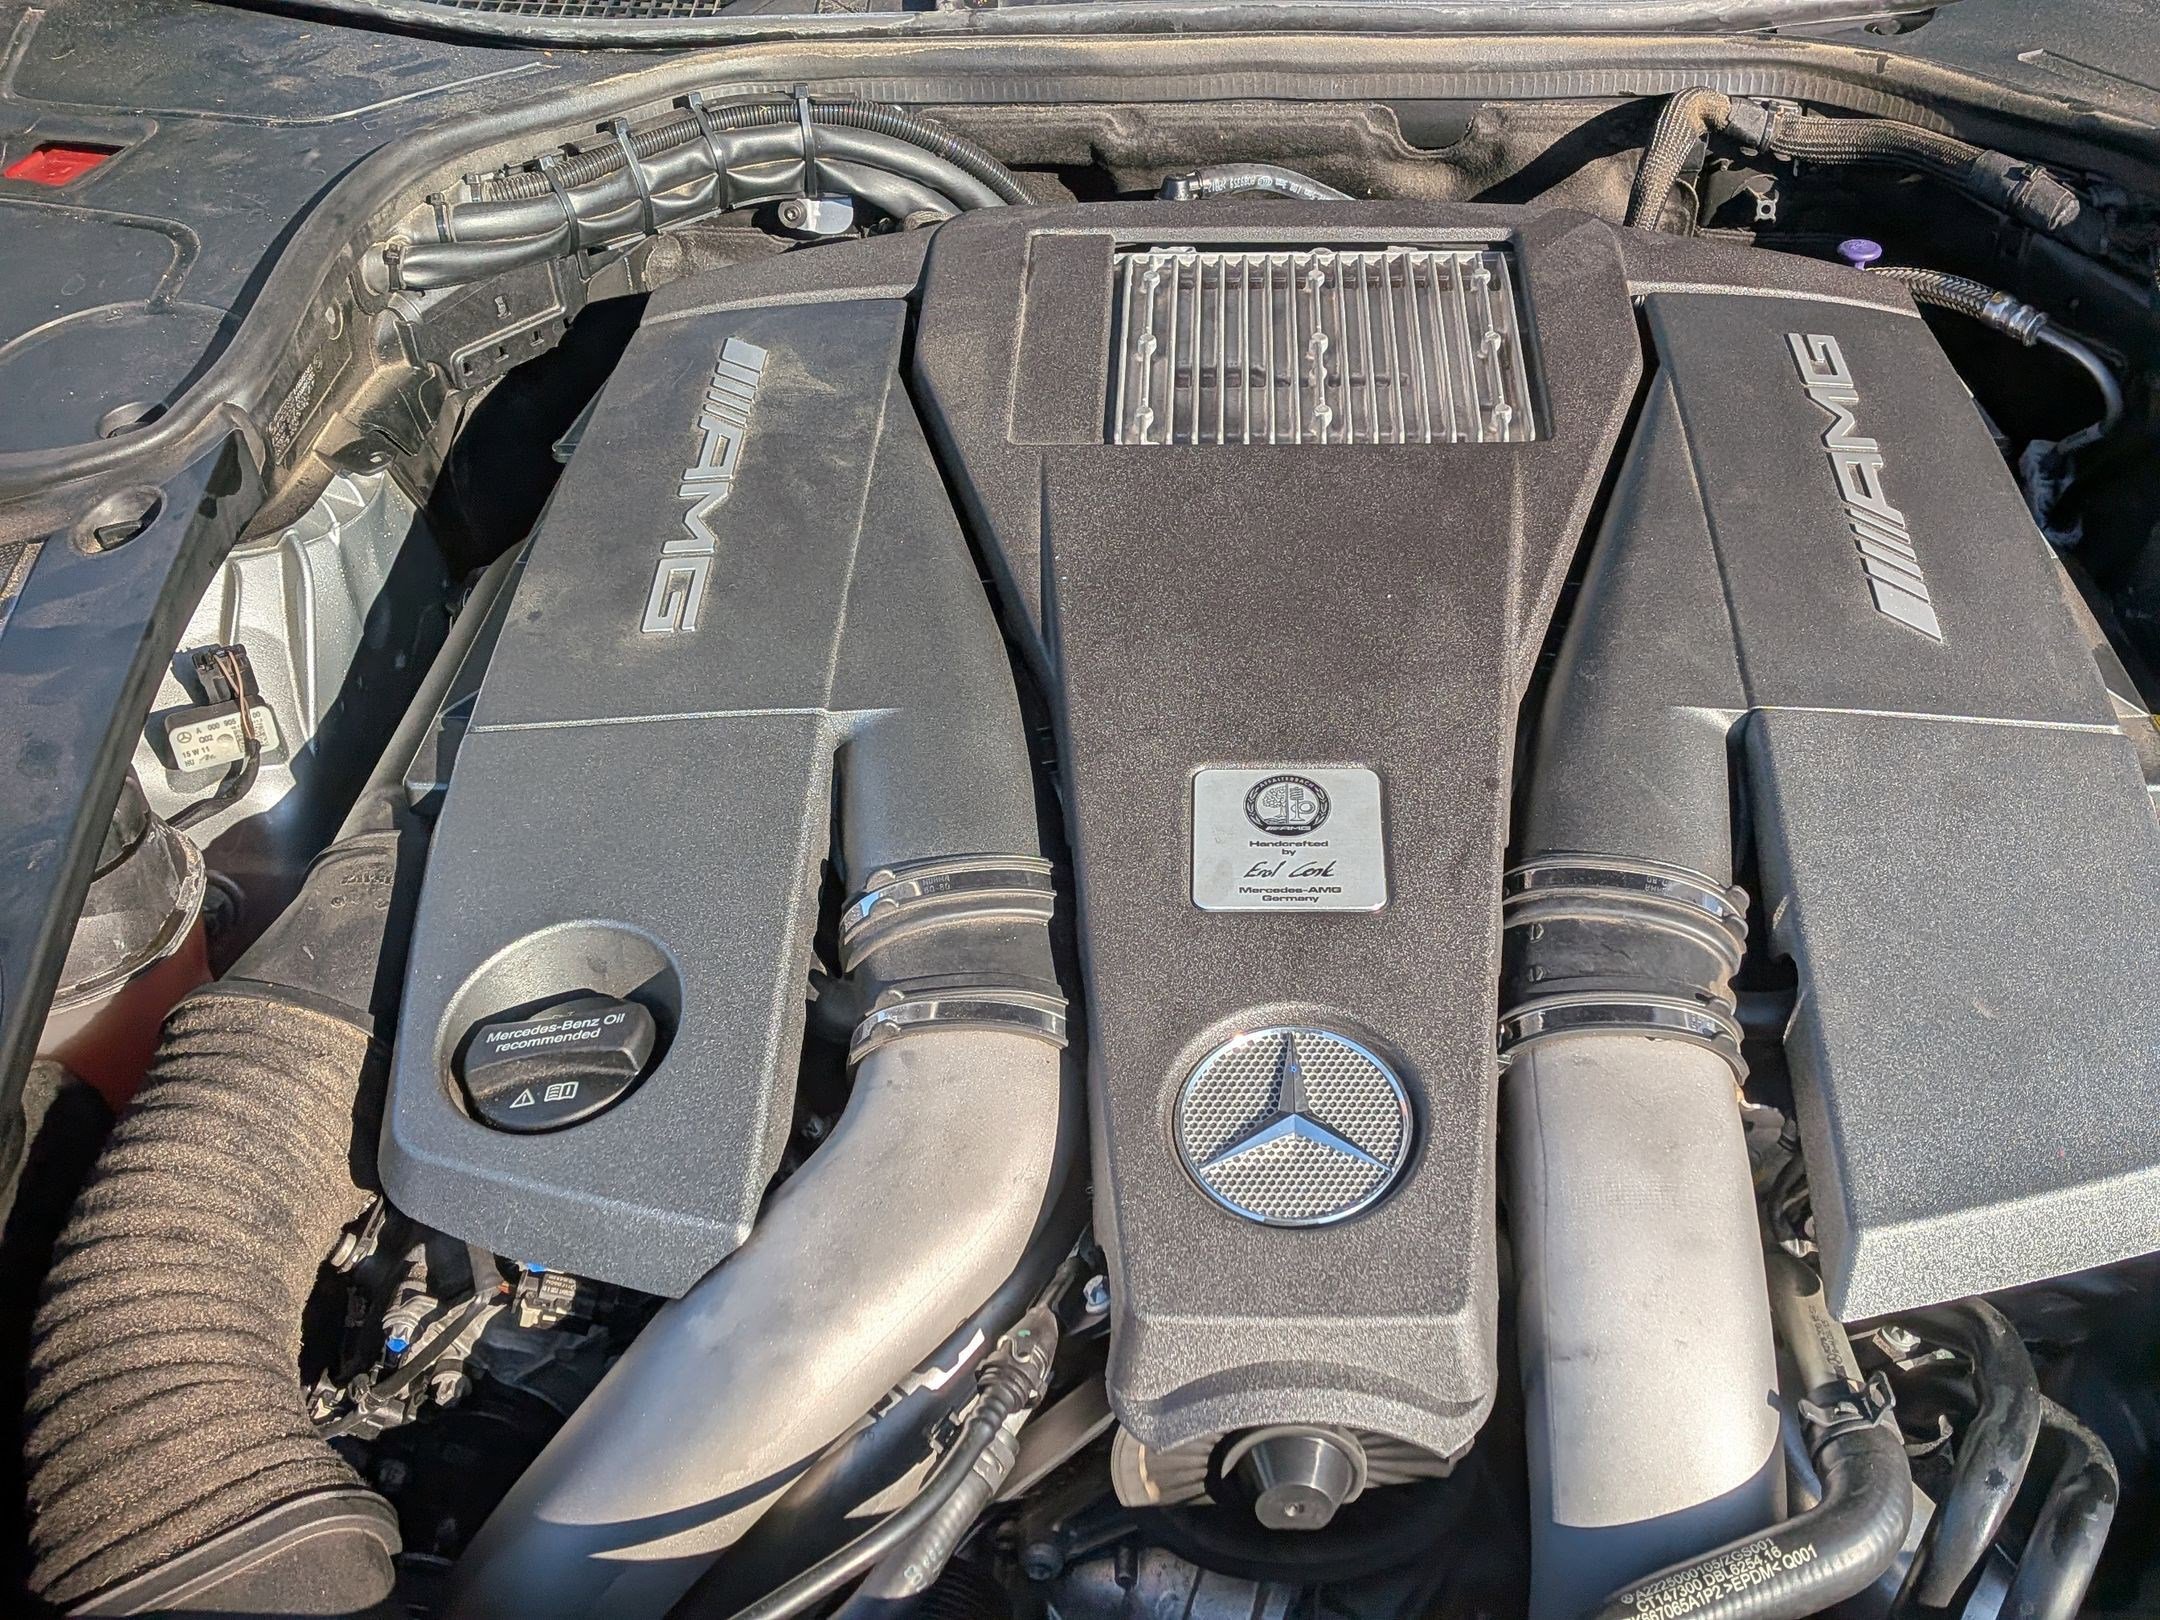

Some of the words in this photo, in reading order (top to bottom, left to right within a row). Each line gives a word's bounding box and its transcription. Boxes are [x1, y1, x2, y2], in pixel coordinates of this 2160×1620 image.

[1782, 331, 1909, 530] AMG
[640, 413, 748, 634] AMG
[207, 722, 221, 731] 000
[182, 751, 191, 759] 15
[1249, 840, 1329, 848] Handcrafted
[1238, 886, 1342, 894] Mercedes-AMG
[485, 1017, 600, 1044] Mercedes-Benz
[603, 1012, 626, 1025] Oil
[495, 1027, 602, 1053] recommended
[1635, 1537, 1775, 1601] A2225000105/ZGS001
[1636, 1578, 1704, 1612] CT147300
[1702, 1545, 1783, 1588] DBL6254.16
[1723, 1560, 1783, 1594] >EPDM<
[1781, 1543, 1819, 1570] Q001
